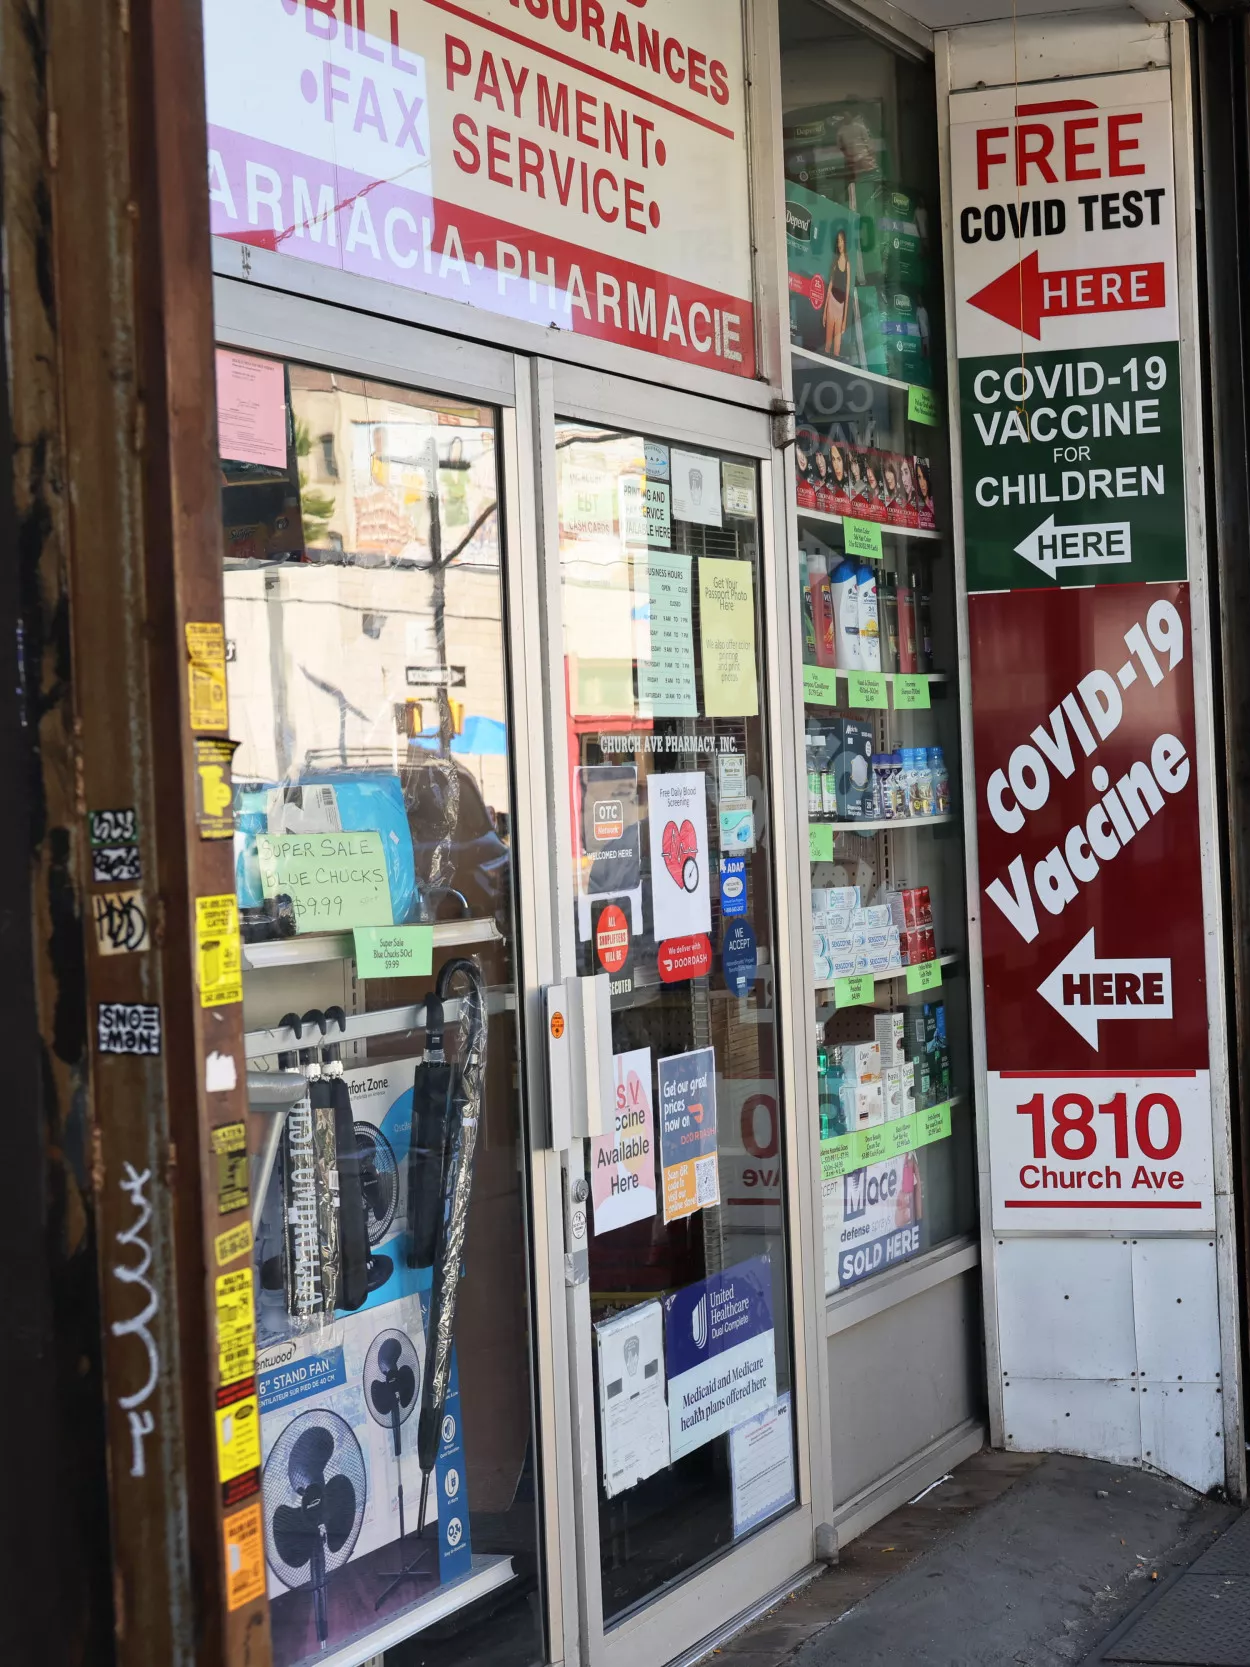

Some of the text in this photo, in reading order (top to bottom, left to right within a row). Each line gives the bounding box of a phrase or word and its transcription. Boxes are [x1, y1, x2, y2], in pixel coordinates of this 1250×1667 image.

[508, 0, 730, 105] SURANCES
[305, 0, 654, 168] BILL PAYMENT
[323, 61, 647, 234] FAX SERVICE
[975, 112, 1146, 191] FREE
[786, 210, 811, 232] Depend
[960, 188, 1165, 244] COVID TEST
[496, 240, 742, 362] PHARMACIE
[1043, 270, 1150, 310] HERE
[973, 355, 1167, 405] COVID-19
[973, 398, 1162, 447] VACCINE
[1053, 445, 1091, 463] FOR
[652, 491, 665, 504] AND
[975, 465, 1165, 507] CHILDREN
[655, 526, 671, 540] HERE
[1037, 529, 1126, 561] HERE
[667, 568, 684, 580] HOURS
[713, 576, 738, 589] Get Your
[705, 587, 747, 601] Passport Photo
[719, 600, 735, 611] Here
[986, 599, 1184, 834] COVID-19
[600, 736, 738, 755] CHURCH AVE PHARMACY, INC.
[659, 788, 670, 798] Free
[671, 788, 682, 799] Daily
[599, 806, 618, 819] OTC
[984, 732, 1190, 944] Vaccine
[261, 839, 373, 861] SUPER SALE
[617, 849, 633, 858] HERE
[265, 868, 384, 888] BLUE CHUCKS
[293, 895, 343, 918] $9.99
[607, 917, 617, 928] ALL
[734, 928, 744, 939] WE
[379, 938, 404, 950] Super Sale
[675, 944, 691, 954] deliver
[729, 938, 750, 951] ACCEPT
[605, 951, 615, 962] WILL
[674, 953, 708, 969] DOORDASH
[609, 979, 632, 995] SECUTED
[1062, 973, 1164, 1005] HERE
[367, 1078, 389, 1091] Zone
[616, 1079, 640, 1109] SV
[664, 1071, 708, 1098] Get our great
[615, 1109, 645, 1131] ccine
[664, 1098, 686, 1120] prices
[664, 1119, 681, 1133] now
[1016, 1092, 1182, 1160] 1810
[597, 1136, 650, 1168] Available
[610, 1172, 639, 1195] Here
[1019, 1165, 1184, 1191] Church Ave
[845, 1168, 898, 1221] Mace
[840, 1222, 870, 1243] defense
[842, 1225, 920, 1280] SOLD HERE
[709, 1284, 734, 1308] United
[710, 1297, 749, 1324] Healthcare
[711, 1314, 749, 1340] Dual Complete
[256, 1350, 292, 1373] entwood
[273, 1359, 330, 1389] STAND FAN
[682, 1357, 764, 1409] Medicaid and Medicare
[259, 1390, 290, 1408] ENTILATEUR
[289, 1388, 300, 1397] SUR
[680, 1375, 767, 1432] health plans offered here
